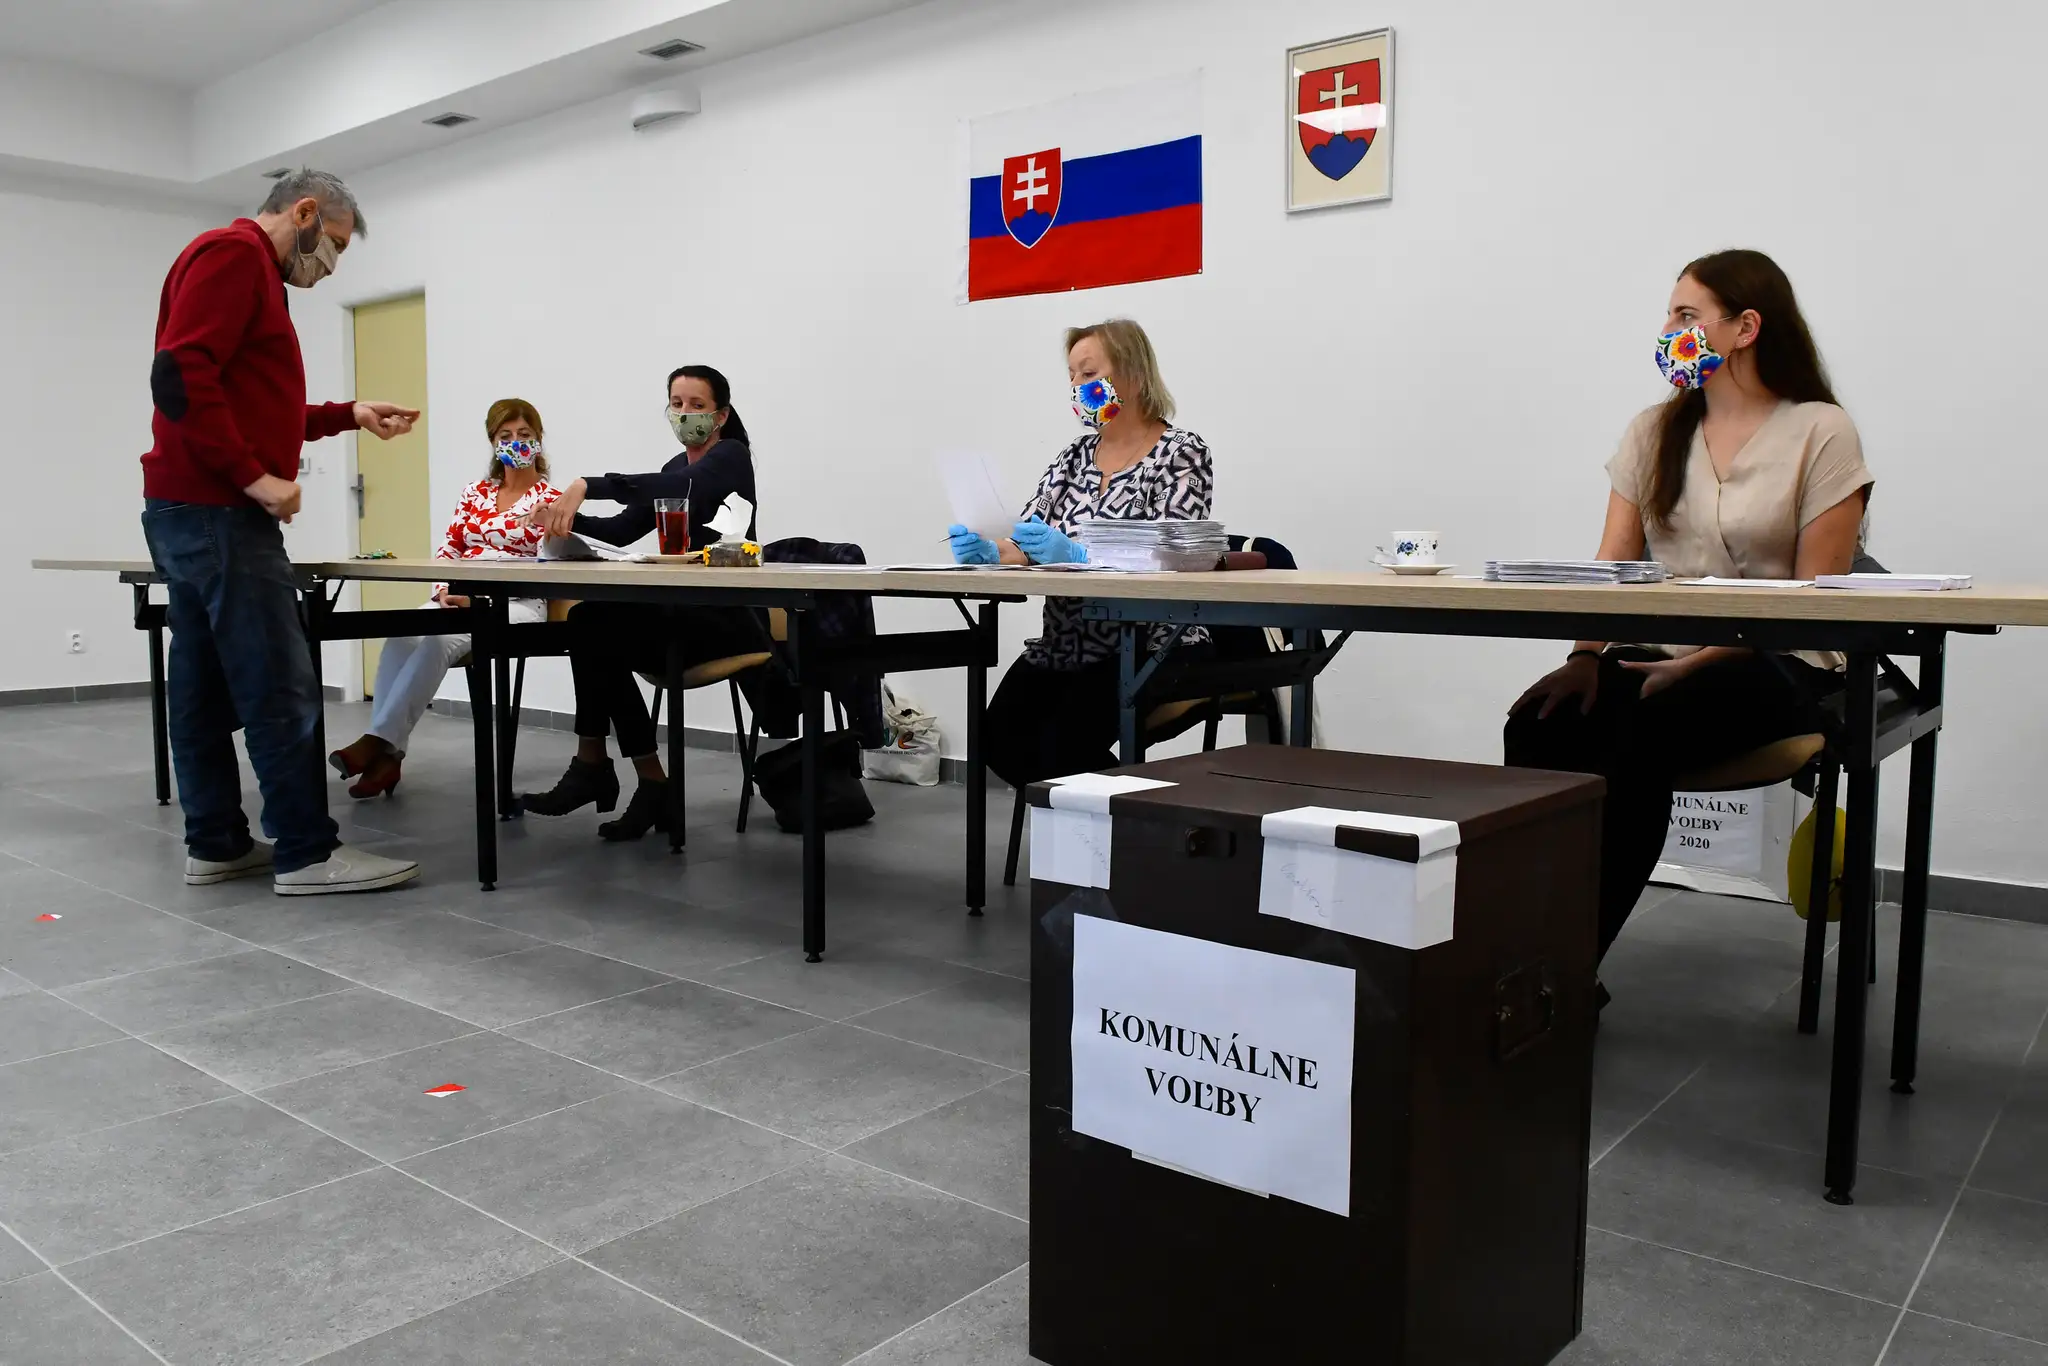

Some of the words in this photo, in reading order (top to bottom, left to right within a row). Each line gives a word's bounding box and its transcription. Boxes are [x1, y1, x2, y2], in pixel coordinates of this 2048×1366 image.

[1679, 835, 1710, 850] 2020
[1099, 1007, 1319, 1090] KOMUNÁLNE
[1144, 1066, 1262, 1124] VOĽBY
